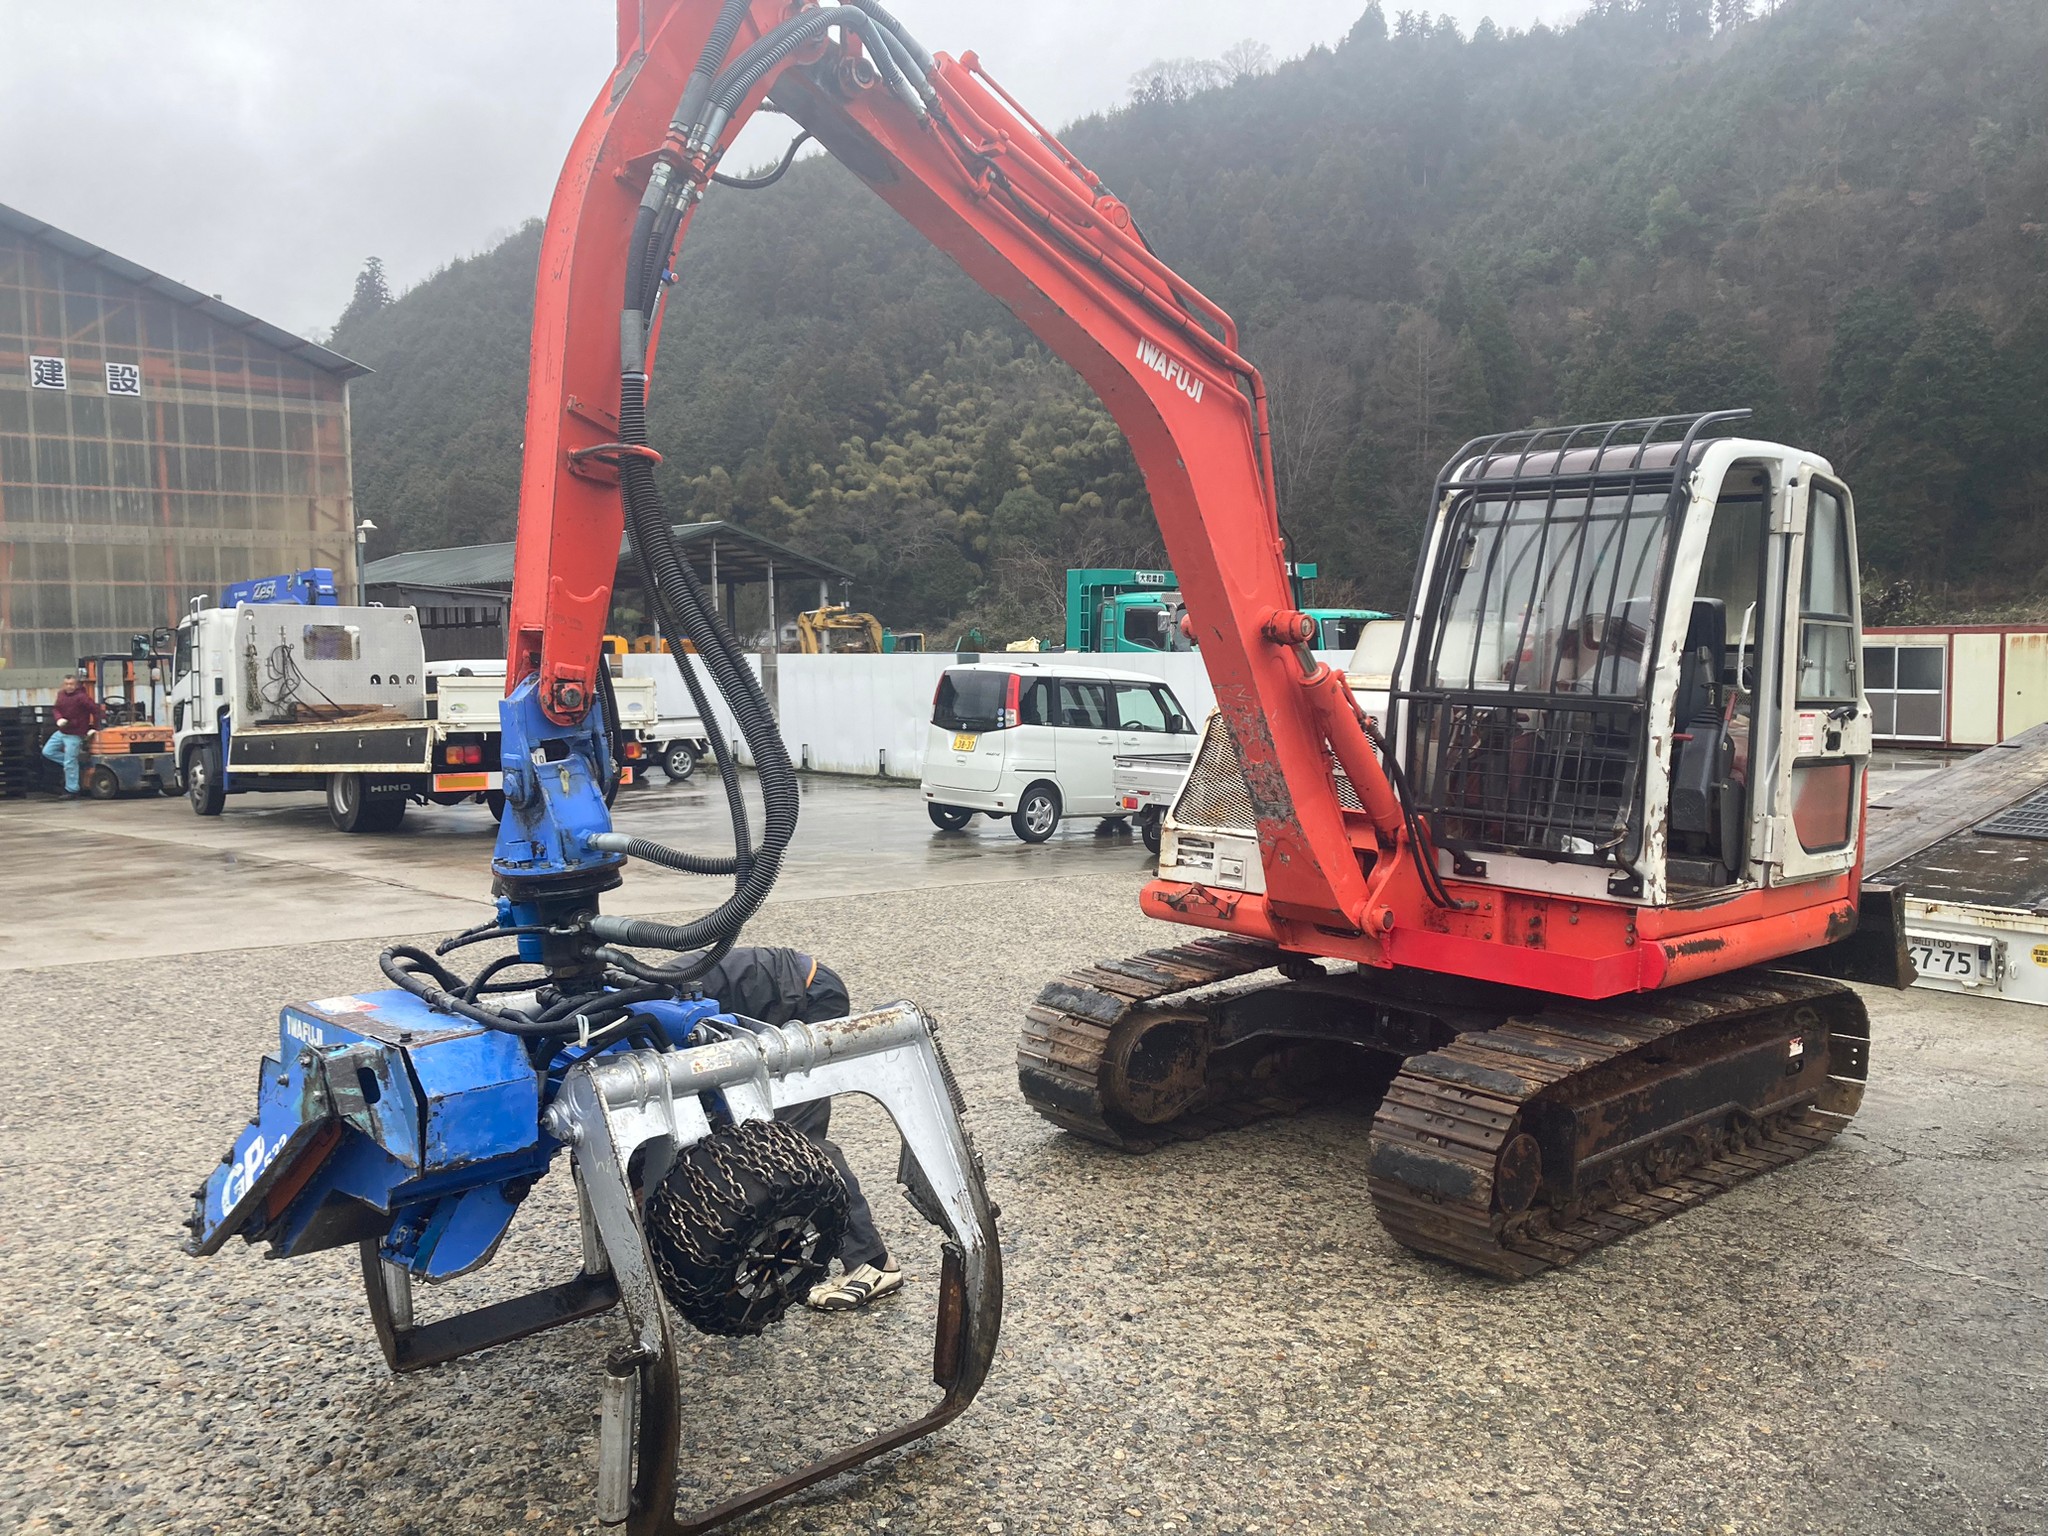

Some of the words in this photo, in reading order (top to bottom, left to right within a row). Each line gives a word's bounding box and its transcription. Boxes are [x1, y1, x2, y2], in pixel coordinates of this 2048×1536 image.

[1136, 336, 1204, 404] IWAFUJI
[371, 783, 411, 793] HINO
[286, 1014, 324, 1047] IWAFUJI
